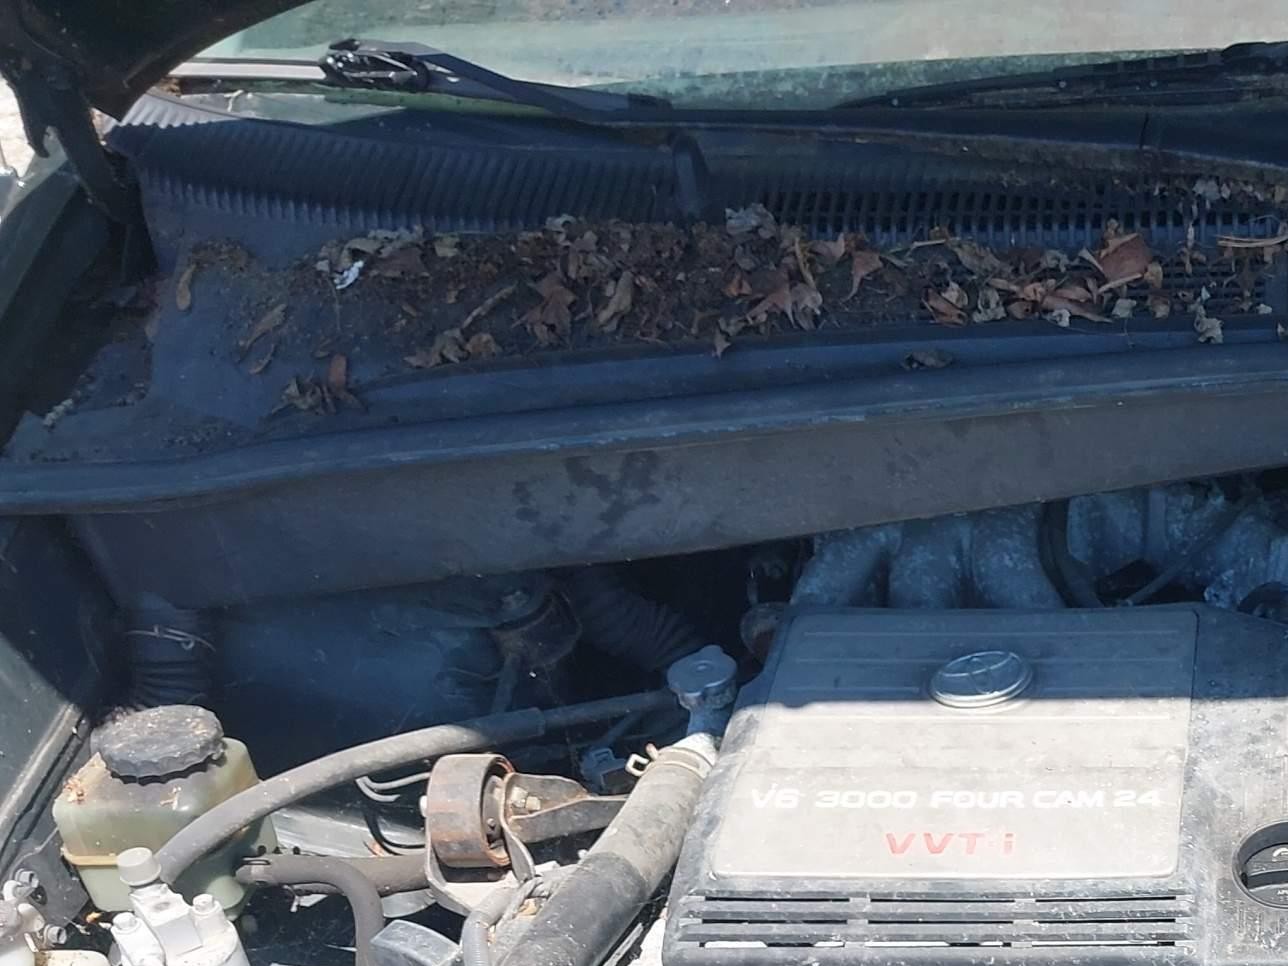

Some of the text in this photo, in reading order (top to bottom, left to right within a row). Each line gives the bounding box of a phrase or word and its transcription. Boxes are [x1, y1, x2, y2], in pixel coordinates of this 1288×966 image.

[751, 788, 1162, 809] V6 3000 FOUR CAM 24
